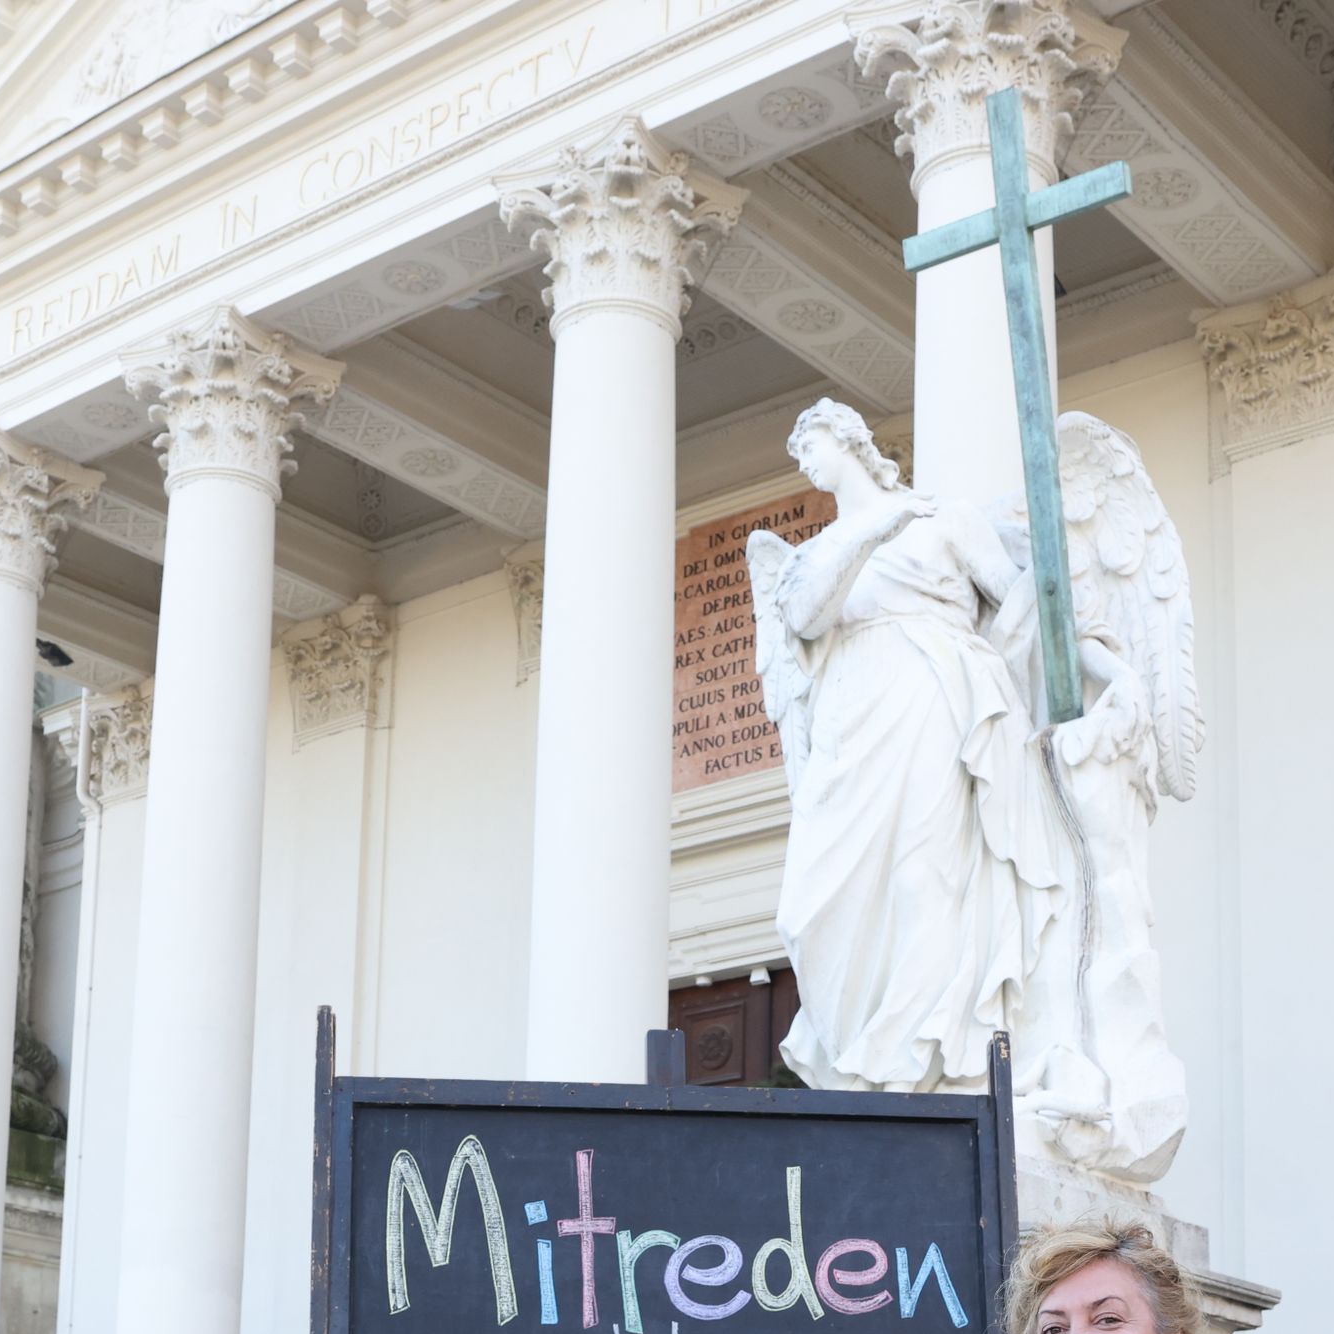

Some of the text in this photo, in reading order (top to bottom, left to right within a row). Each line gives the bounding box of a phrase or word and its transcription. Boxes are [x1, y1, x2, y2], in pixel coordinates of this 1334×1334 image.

[9, 233, 182, 355] REDDAM
[219, 193, 261, 252] IN
[709, 504, 805, 549] IN GLORIAM
[683, 558, 708, 579] DEI
[702, 589, 752, 617] DEPRE
[675, 648, 706, 670] REX
[695, 658, 750, 686] SOLVIT
[732, 678, 760, 699] PRO
[734, 699, 767, 721] MDC
[679, 734, 726, 759] ANNO
[705, 746, 763, 775] FACTUS
[385, 1133, 969, 1334] Mitreden
